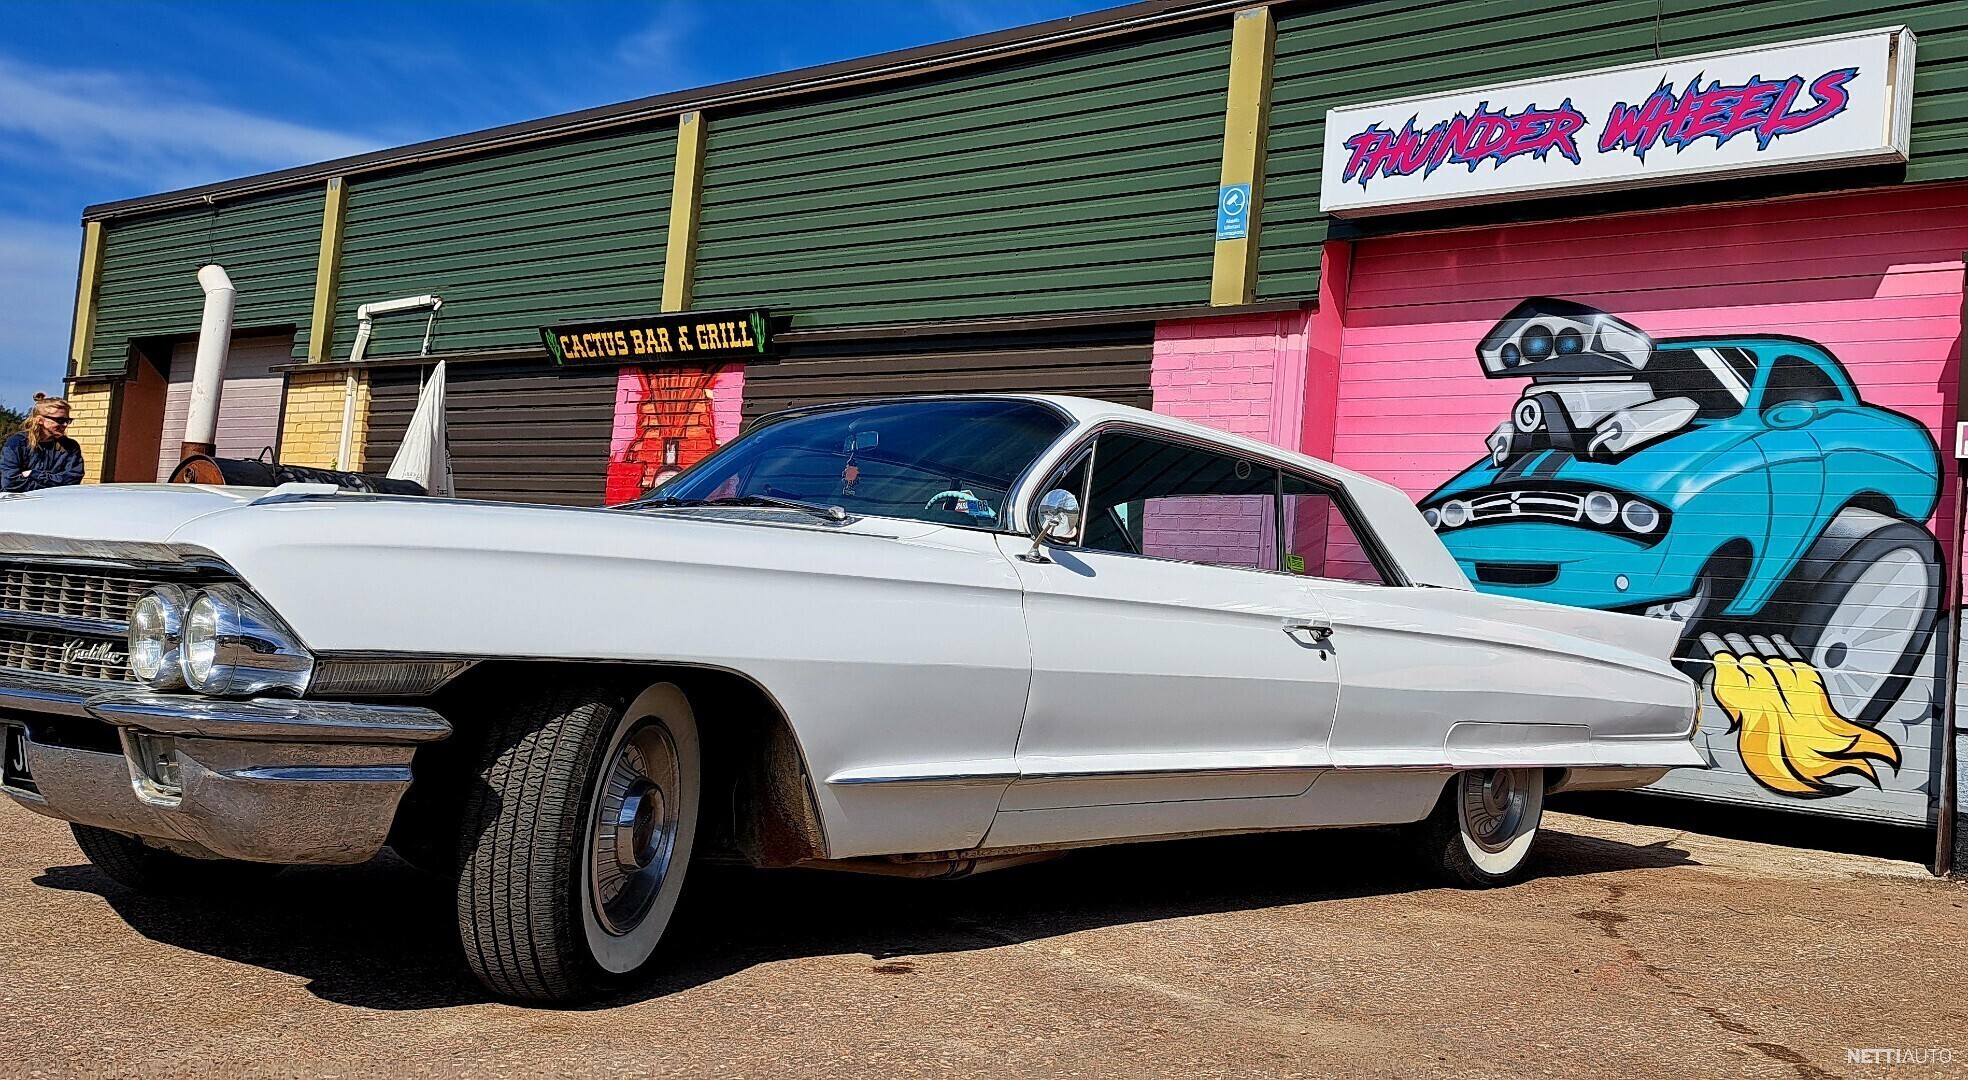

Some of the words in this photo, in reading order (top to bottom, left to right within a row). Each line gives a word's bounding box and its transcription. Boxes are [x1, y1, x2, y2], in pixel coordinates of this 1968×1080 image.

[1342, 98, 1587, 190] THUNDER
[1598, 67, 1859, 164] WHEELS
[559, 330, 629, 359] CACTUS
[630, 326, 673, 356] BAR
[678, 325, 693, 352] &
[695, 320, 754, 350] GRILL
[62, 638, 124, 664] Cadillac
